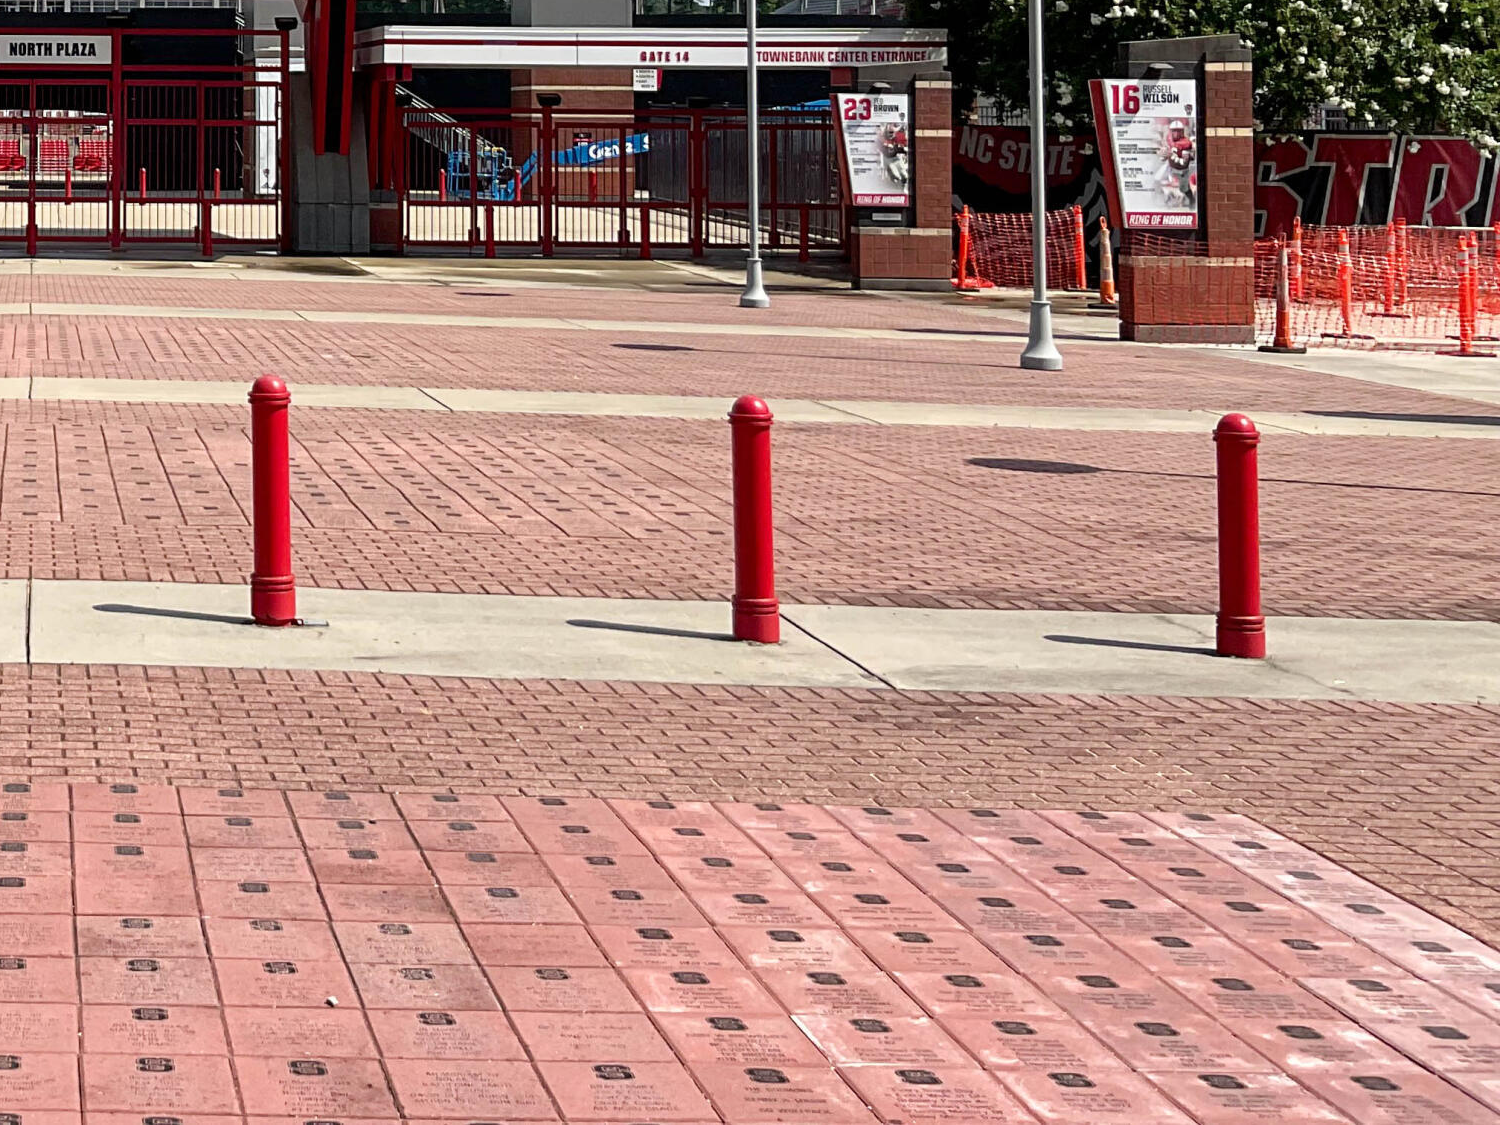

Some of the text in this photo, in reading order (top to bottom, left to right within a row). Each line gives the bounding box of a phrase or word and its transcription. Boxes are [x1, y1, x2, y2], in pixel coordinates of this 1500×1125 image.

[9, 42, 97, 57] NORTH PLAZA
[640, 51, 689, 62] GATE 14
[756, 50, 927, 63] TOWNEBANK CENTER ENTRANCE
[1142, 84, 1172, 94] RUSSELL
[1111, 84, 1140, 115] 16
[1142, 94, 1179, 104] WILSON
[843, 98, 872, 121] 23
[873, 104, 899, 112] BROWN
[588, 141, 634, 159] Gene
[959, 126, 994, 164] NC
[998, 139, 1076, 175] STTE
[1129, 215, 1193, 225] RING OF HONOR
